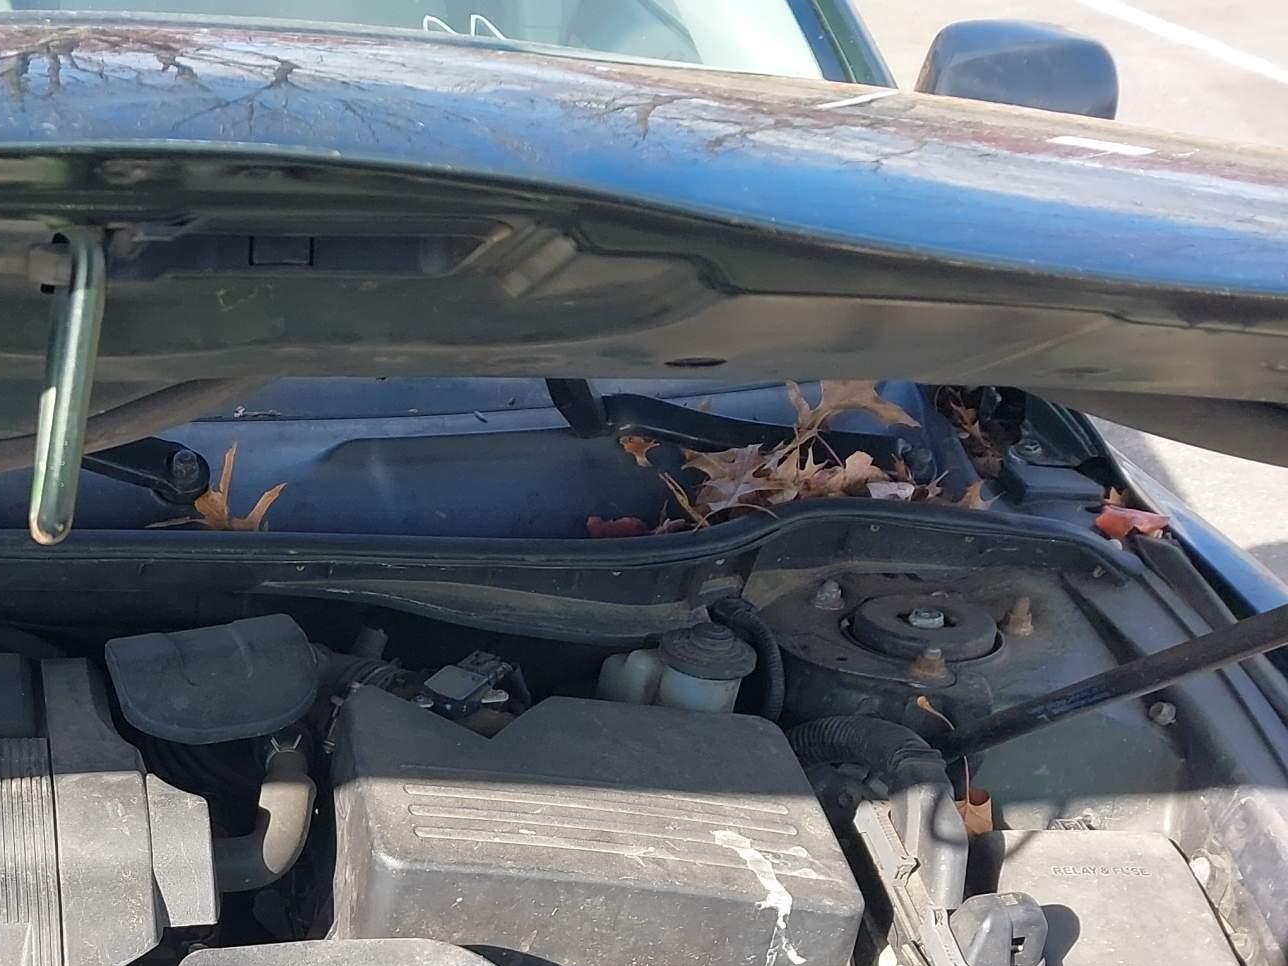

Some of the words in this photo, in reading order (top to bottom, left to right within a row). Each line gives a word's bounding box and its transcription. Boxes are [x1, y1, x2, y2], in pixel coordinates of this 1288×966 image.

[1051, 865, 1098, 876] RELAY
[1100, 866, 1110, 876] &
[1112, 866, 1152, 877] FUSE
